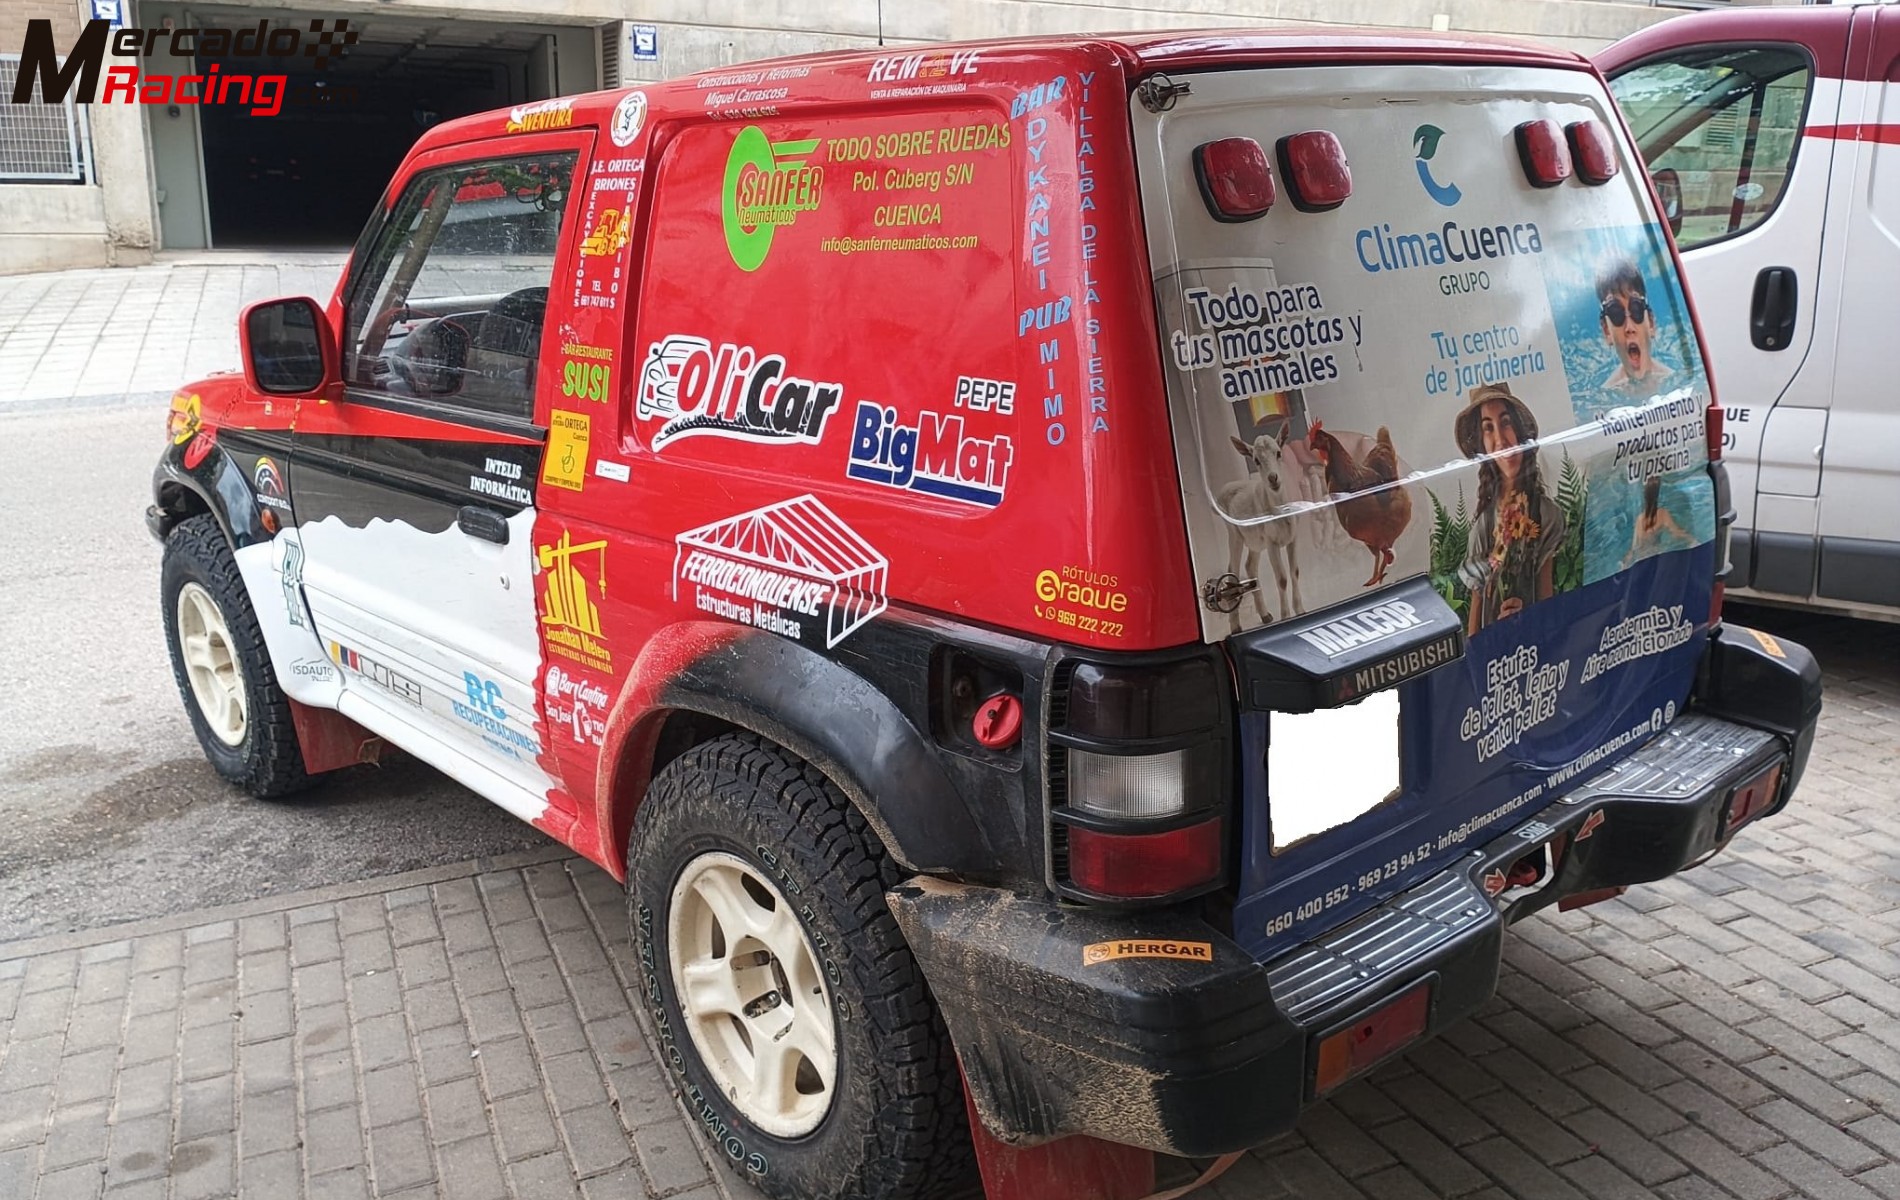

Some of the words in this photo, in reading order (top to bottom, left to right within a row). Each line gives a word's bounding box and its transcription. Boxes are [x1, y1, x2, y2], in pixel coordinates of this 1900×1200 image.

[704, 89, 738, 108] Miguel
[737, 87, 788, 103] Carrascosa
[1011, 75, 1067, 120] BAR
[522, 108, 573, 132] AVENTURA
[827, 136, 872, 163] TODO
[875, 130, 933, 159] SOBRE
[935, 123, 1011, 153] RUEDAS
[1077, 71, 1096, 212] VILLALBA
[594, 177, 636, 191] BRIONES
[607, 158, 645, 173] ORTEGA
[853, 170, 879, 192] Pol.
[885, 166, 941, 192] Cuberg
[945, 163, 975, 186] S/N
[874, 203, 941, 227] CUENCA
[821, 234, 978, 255] info@sanferneumaticos.com
[1080, 225, 1098, 260] DE
[1356, 221, 1543, 272] ClimaCuenca
[1083, 270, 1100, 305] LA
[1439, 271, 1490, 296] GRUPO
[1019, 296, 1072, 337] PUB
[1188, 286, 1259, 325] Todo
[1266, 285, 1322, 323] para
[1174, 334, 1214, 366] tus
[1221, 316, 1343, 360] mascotas
[1348, 314, 1363, 346] y
[1431, 331, 1458, 359] Tu
[1463, 324, 1520, 355] centro
[562, 360, 610, 404] SUSI
[1085, 319, 1109, 433] SIERRA
[1223, 351, 1338, 397] animales
[1425, 365, 1447, 394] de
[1455, 344, 1545, 396] jardinería
[676, 347, 840, 438] OliCar
[957, 379, 1013, 411] PEPE
[1040, 339, 1065, 446] MIMO
[565, 418, 588, 432] ORTEGA
[851, 403, 1012, 485] BigMat
[1613, 425, 1678, 466] productos
[1681, 419, 1705, 446] para
[485, 458, 522, 479] INTELIS
[1628, 460, 1641, 481] tu
[1644, 449, 1689, 482] piscina
[470, 476, 532, 505] INFORMÁTICA
[681, 551, 831, 617] FERROCONQUENSE
[1062, 565, 1118, 587] RÓTULOS
[696, 585, 752, 624] Estructuras
[754, 603, 800, 640] Metálicas
[1057, 609, 1077, 626] 969
[1078, 615, 1098, 632] 222
[1099, 621, 1123, 637] 222
[1297, 601, 1422, 656] MALCOP
[1600, 605, 1670, 652] Aerotermia
[1668, 604, 1684, 630] y
[1356, 638, 1454, 693] MITSUBISHI
[1487, 645, 1537, 692] Estufas
[1580, 653, 1606, 684] Aire
[463, 671, 507, 720] RC
[1461, 707, 1481, 741] de
[1525, 665, 1559, 701] leña
[1558, 659, 1570, 690] y
[1476, 717, 1512, 763] venta
[1513, 689, 1557, 744] pellet
[1266, 912, 1293, 937] 660
[1296, 897, 1323, 920] 400
[1325, 884, 1349, 908] 552
[1358, 869, 1381, 892] 969
[1383, 859, 1398, 880] 23
[1401, 851, 1415, 870] 94
[1417, 842, 1431, 862] 52
[1437, 784, 1543, 851] info@climacuenca.com
[1548, 720, 1651, 789] www.climacuenca.com
[1118, 943, 1206, 957] HERGAR
